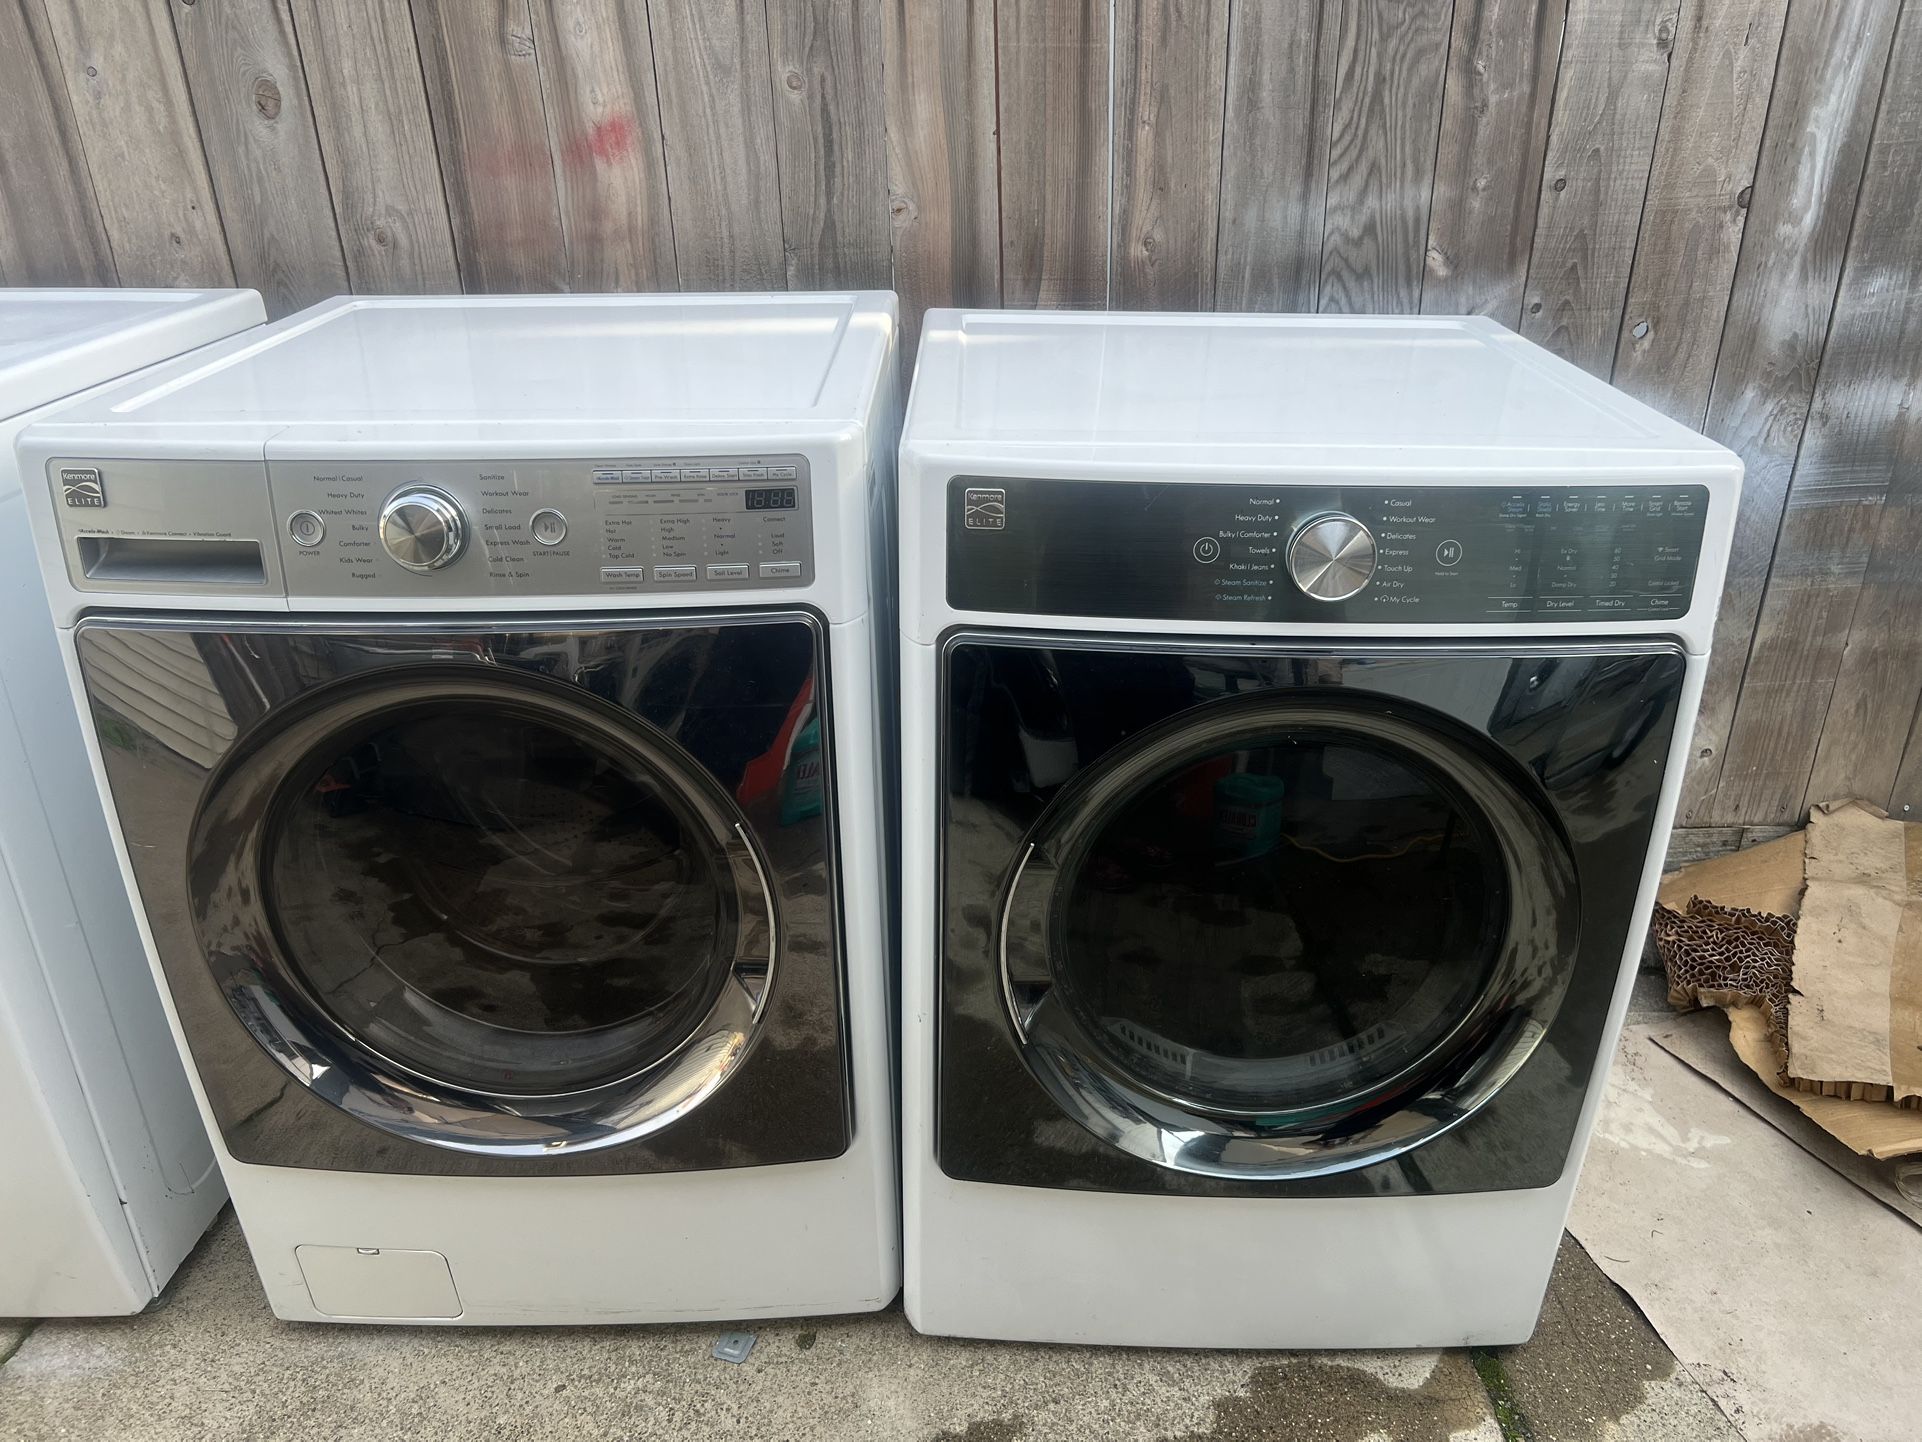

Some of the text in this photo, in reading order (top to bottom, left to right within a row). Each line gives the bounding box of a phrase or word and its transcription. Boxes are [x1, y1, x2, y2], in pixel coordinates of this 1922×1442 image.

[62, 472, 95, 480] Kenmore
[1390, 499, 1412, 507] Casual
[968, 518, 1002, 526] ELITE
[1235, 514, 1273, 522] Heavy Duty
[351, 524, 369, 532] Bulky
[1219, 530, 1236, 539] Bulky
[1386, 532, 1416, 540] Delicates
[338, 540, 371, 548] Comforter
[1249, 546, 1270, 554] Towels
[1385, 548, 1409, 556] Express
[488, 555, 503, 563] Cold
[1383, 564, 1413, 573] Touch Up
[351, 572, 376, 580] Rugged
[515, 571, 530, 579] Spin
[1221, 578, 1267, 586] Steam Sanitize
[1392, 580, 1405, 588] Dry
[1389, 595, 1420, 604] My Cycle
[1596, 599, 1614, 607] Timed
[1502, 600, 1519, 608] Temp
[1546, 600, 1557, 608] Dry
